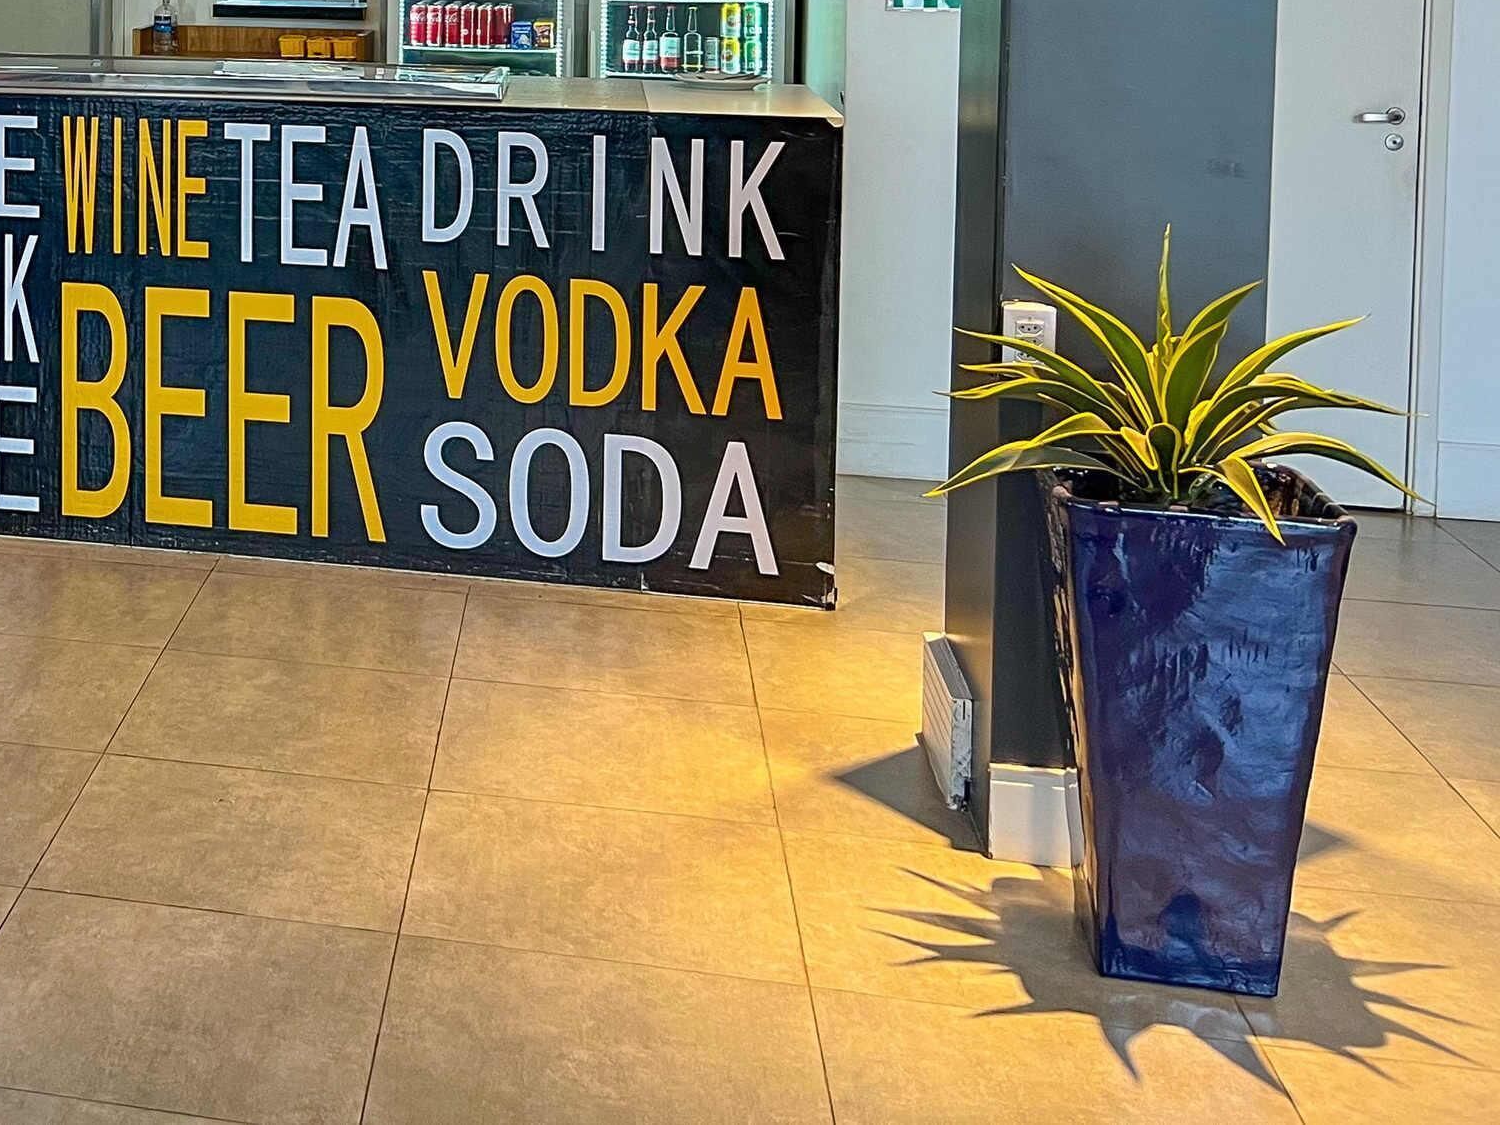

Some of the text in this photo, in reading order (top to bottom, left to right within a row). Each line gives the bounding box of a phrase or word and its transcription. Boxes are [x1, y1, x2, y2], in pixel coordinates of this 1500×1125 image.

[62, 115, 210, 259] WINE
[224, 122, 388, 270] TEA
[422, 128, 786, 261] DRINK
[61, 281, 387, 543] BEER
[422, 270, 784, 420] VODKA
[420, 421, 779, 576] SODA
